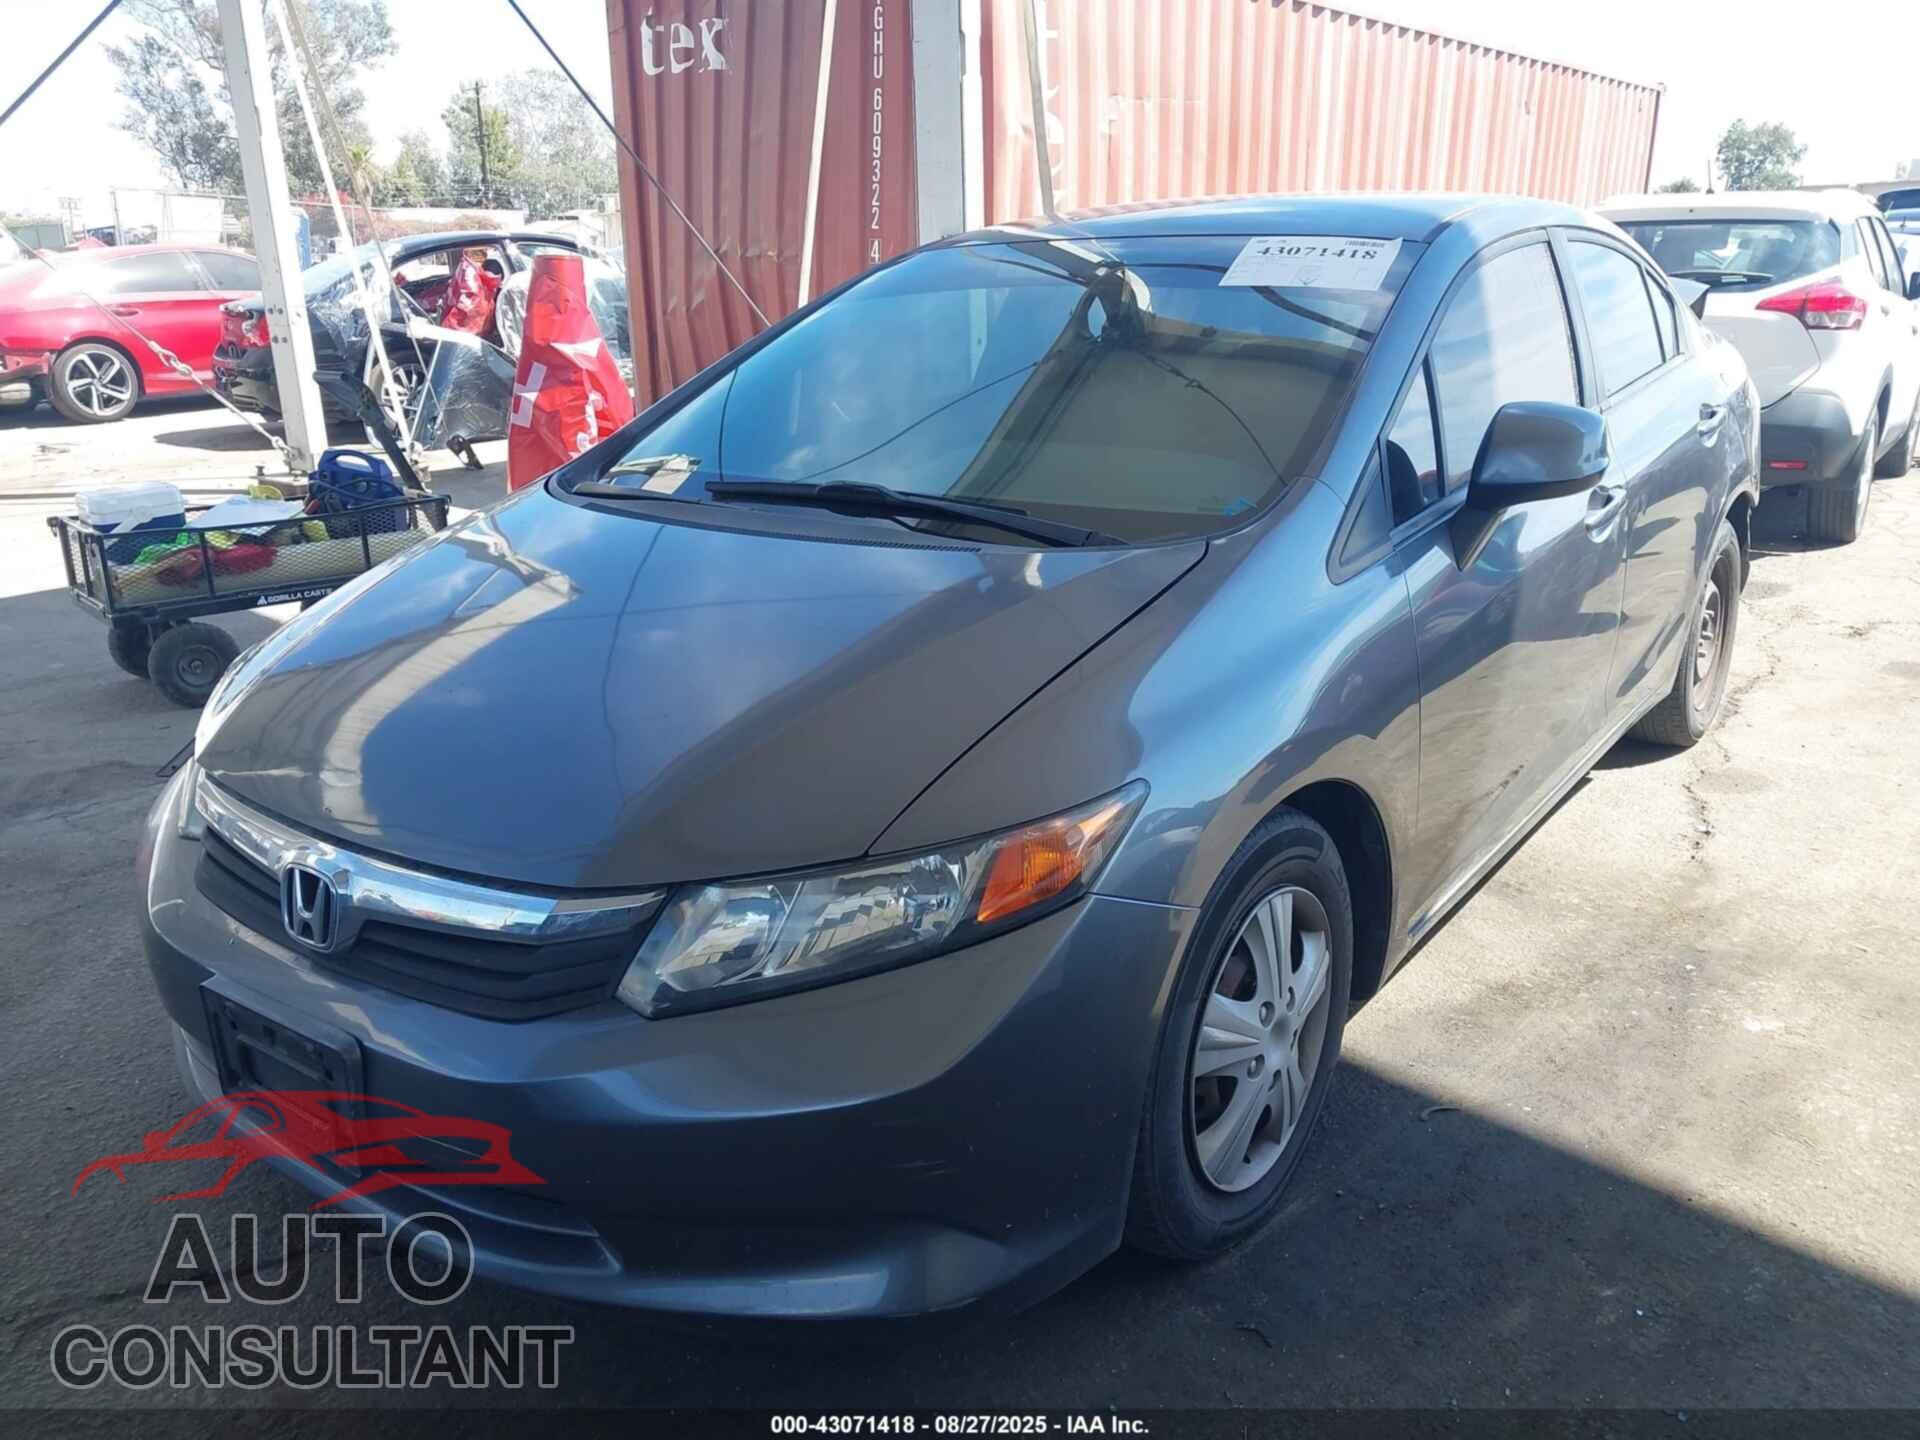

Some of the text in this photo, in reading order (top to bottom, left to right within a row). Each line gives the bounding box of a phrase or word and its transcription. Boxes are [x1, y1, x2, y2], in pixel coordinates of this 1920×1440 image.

[640, 6, 731, 76] tex
[872, 0, 884, 79] GHU
[871, 88, 883, 229] 609322
[1256, 246, 1377, 259] 43071418
